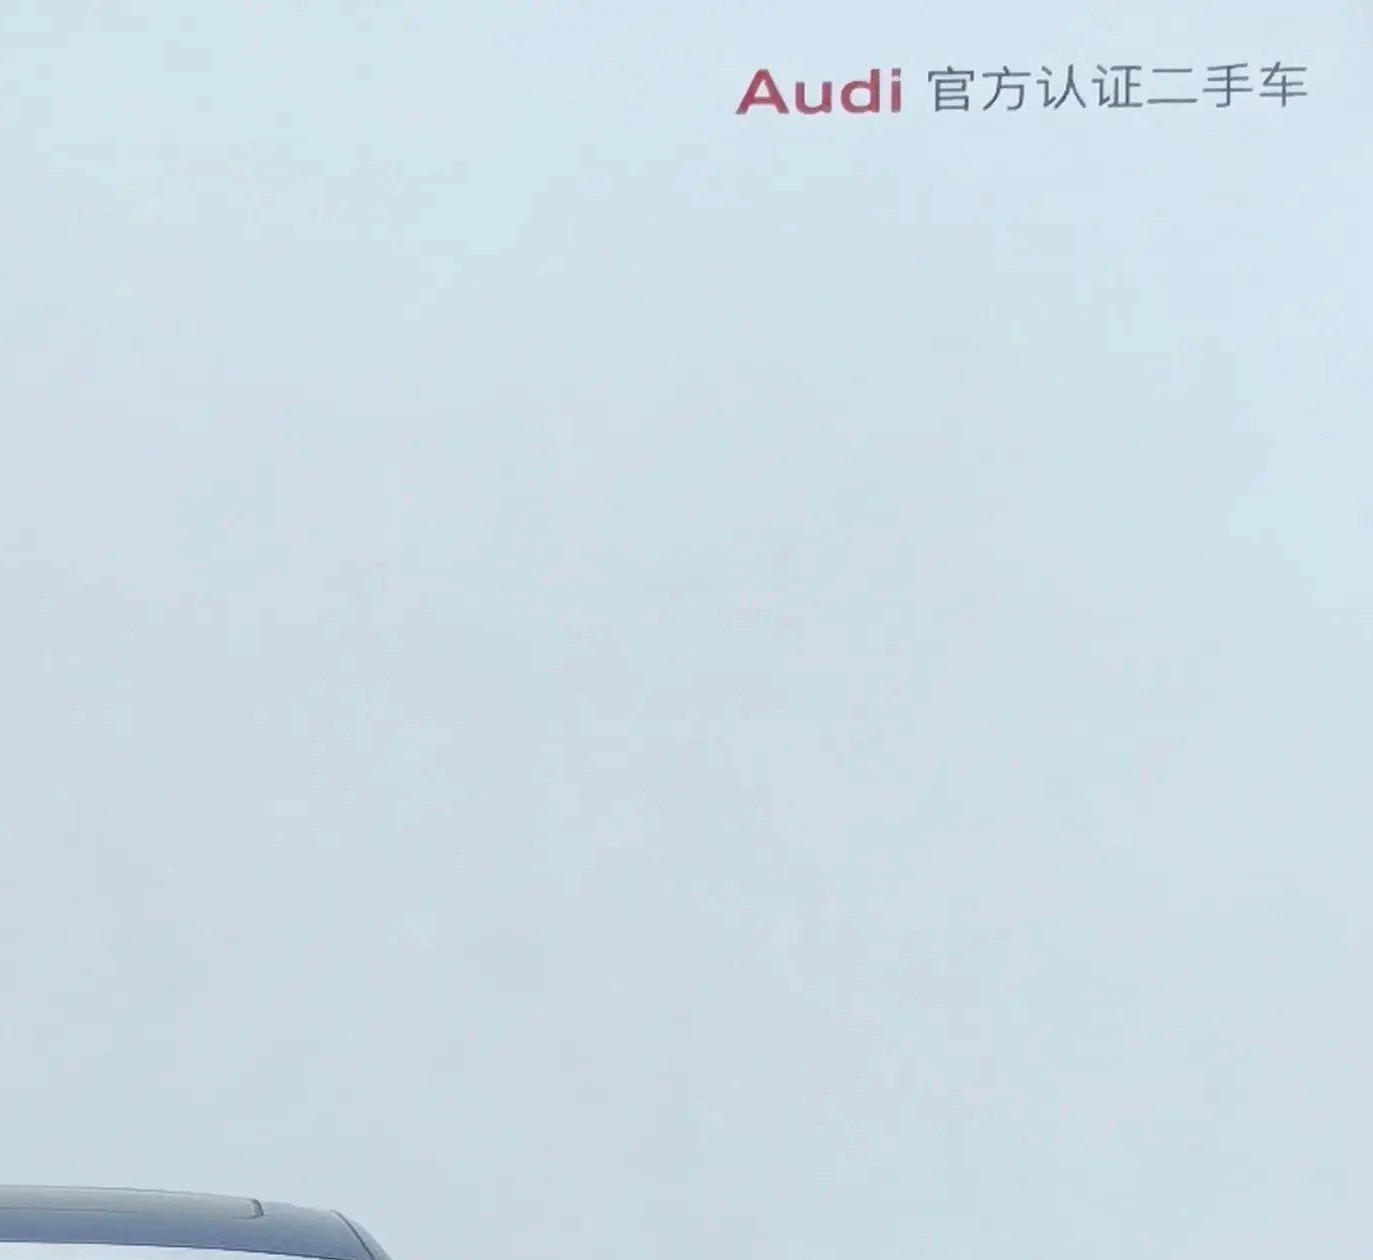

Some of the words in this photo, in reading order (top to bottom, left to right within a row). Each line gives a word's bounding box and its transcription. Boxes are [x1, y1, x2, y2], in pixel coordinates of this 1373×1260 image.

[734, 67, 903, 115] Audi
[927, 60, 1308, 112] 官方认证二手车
